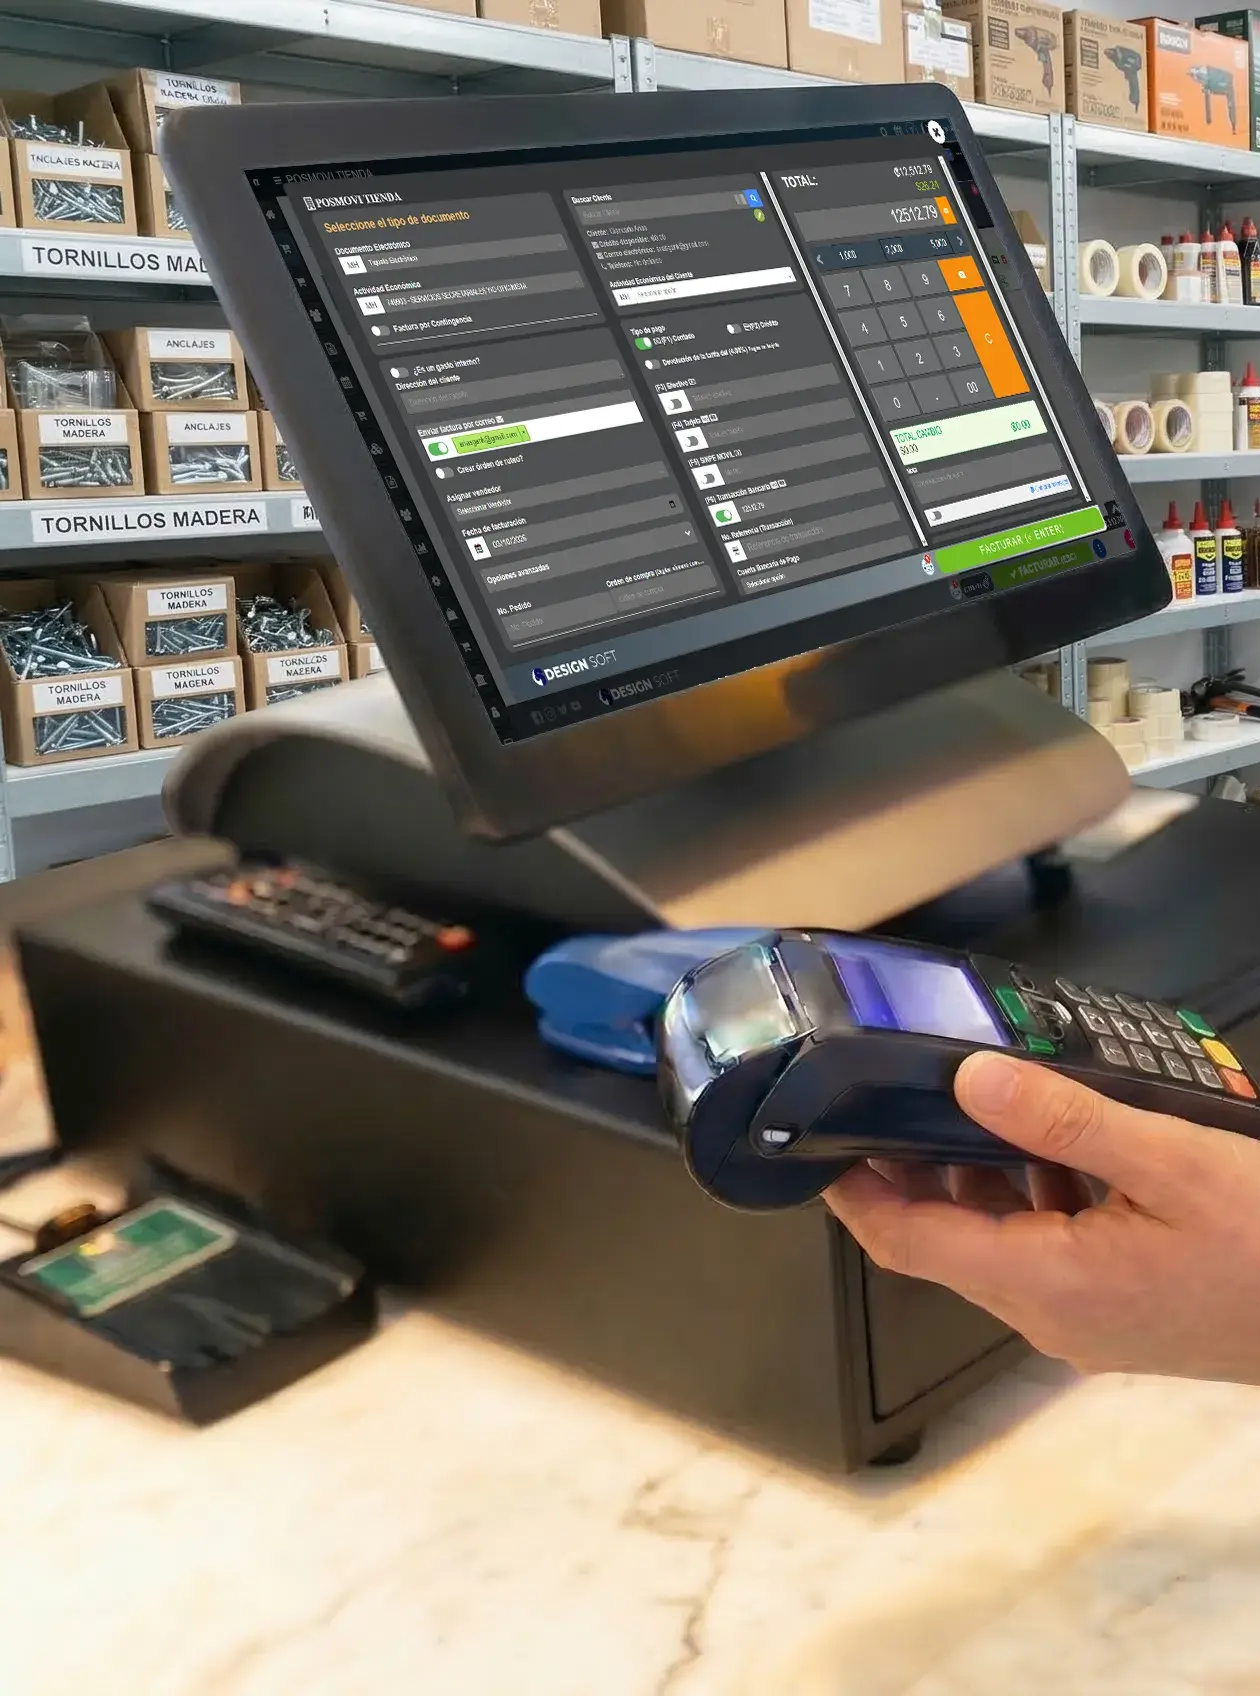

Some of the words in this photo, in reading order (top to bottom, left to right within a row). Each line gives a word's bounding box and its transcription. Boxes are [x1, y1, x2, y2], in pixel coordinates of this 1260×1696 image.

[781, 174, 818, 188] TOTAL:
[315, 194, 363, 209] POSMOVI
[362, 191, 401, 204] TIENDA
[571, 195, 592, 203] Buscar
[591, 193, 612, 201] Cliente
[889, 204, 938, 223] 12512.79
[323, 218, 376, 233] Seleccione
[376, 217, 386, 228] el
[386, 215, 407, 229] tipo
[406, 214, 420, 225] de
[419, 209, 470, 224] documento
[334, 244, 373, 255] Documento
[372, 239, 411, 251] Electrónico
[32, 246, 160, 271] TORNILLOS
[609, 278, 635, 288] Actividad
[635, 273, 665, 284] Económica
[674, 271, 693, 279] Cliente
[883, 279, 892, 291] 8
[921, 273, 929, 285] 9
[352, 284, 384, 295] Actividad
[384, 279, 421, 291] Económica
[843, 284, 852, 297] 7
[899, 315, 907, 327] 5
[936, 309, 945, 321] 6
[393, 322, 418, 332] Factura
[419, 321, 430, 330] por
[430, 314, 472, 328] Contingencia
[759, 318, 778, 328] Crédito
[859, 322, 868, 335] 4
[630, 327, 644, 337] Tipo
[643, 326, 650, 334] de
[650, 325, 666, 334] pago
[672, 332, 695, 342] Contado
[166, 339, 215, 349] ANCLAJES
[952, 345, 961, 357] 3
[662, 354, 692, 366] Devolución
[915, 352, 923, 364] 2
[412, 365, 426, 376] ¿Es
[435, 361, 454, 372] gasto
[454, 357, 480, 367] interno?
[877, 360, 884, 371] 1
[395, 378, 427, 390] Dirección
[427, 377, 438, 385] del
[438, 373, 461, 384] cliente
[666, 379, 688, 389] Efectivo
[966, 381, 978, 393] 00
[893, 397, 901, 409] 0
[184, 422, 231, 431] ANCLAJES
[417, 426, 439, 436] Enviar
[439, 422, 462, 433] factura
[462, 421, 474, 430] por
[474, 417, 495, 426] correo
[63, 429, 106, 438] MADERA
[894, 430, 917, 444] TOTAL
[457, 464, 474, 473] Crear
[494, 458, 503, 466] de
[503, 454, 524, 464] ruteo?
[445, 490, 472, 503] Asignar
[471, 484, 502, 497] vendedor
[716, 488, 747, 500] Transacción
[41, 511, 166, 534] TORNILLOS
[173, 508, 260, 528] MADERA
[461, 526, 482, 537] Fecha
[482, 524, 491, 532] de
[490, 515, 526, 530] facturación
[731, 526, 758, 538] Referencia
[979, 534, 1023, 556] FACTURAR
[786, 554, 801, 565] Pago
[1018, 555, 1060, 576] FACTURAR
[486, 570, 517, 585] Opciones
[517, 562, 549, 576] avanzadas
[605, 576, 625, 587] Orden
[624, 574, 632, 582] de
[632, 570, 654, 582] compra
[160, 588, 214, 600] TORNILLOS
[497, 606, 509, 615] No.
[509, 600, 532, 612] Pedido
[543, 657, 588, 680] DESIGN
[588, 649, 618, 667] SOFT
[166, 666, 220, 679] TORNILLOS
[48, 680, 107, 695] TORNILLOS
[610, 677, 652, 700] DESIGN
[653, 668, 682, 687] SOFT
[56, 693, 102, 705] MADERA
